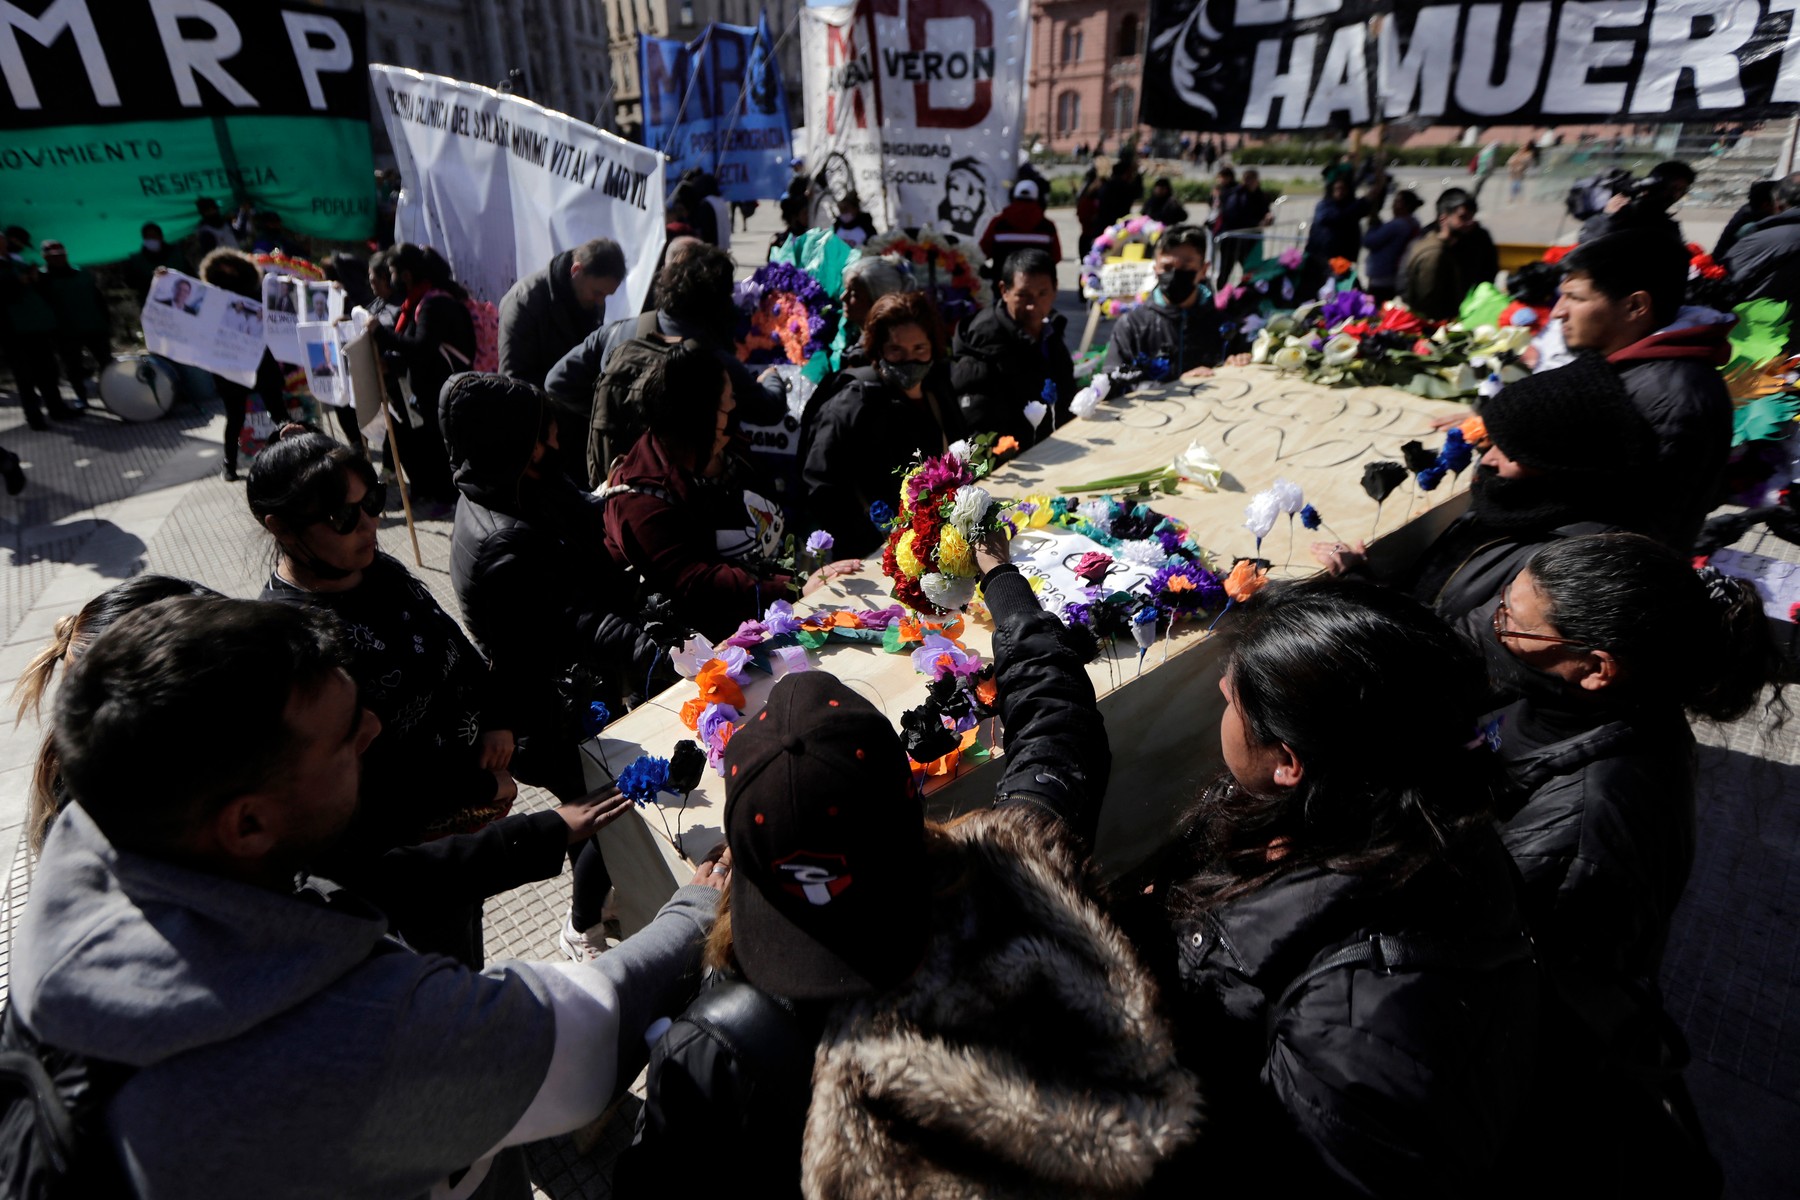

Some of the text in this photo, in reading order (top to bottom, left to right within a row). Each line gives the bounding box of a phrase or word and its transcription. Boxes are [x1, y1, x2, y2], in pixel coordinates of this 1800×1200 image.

[883, 48, 995, 80] VERON
[452, 105, 469, 136] DEL
[550, 141, 587, 184] VITAL
[591, 154, 604, 190] Y
